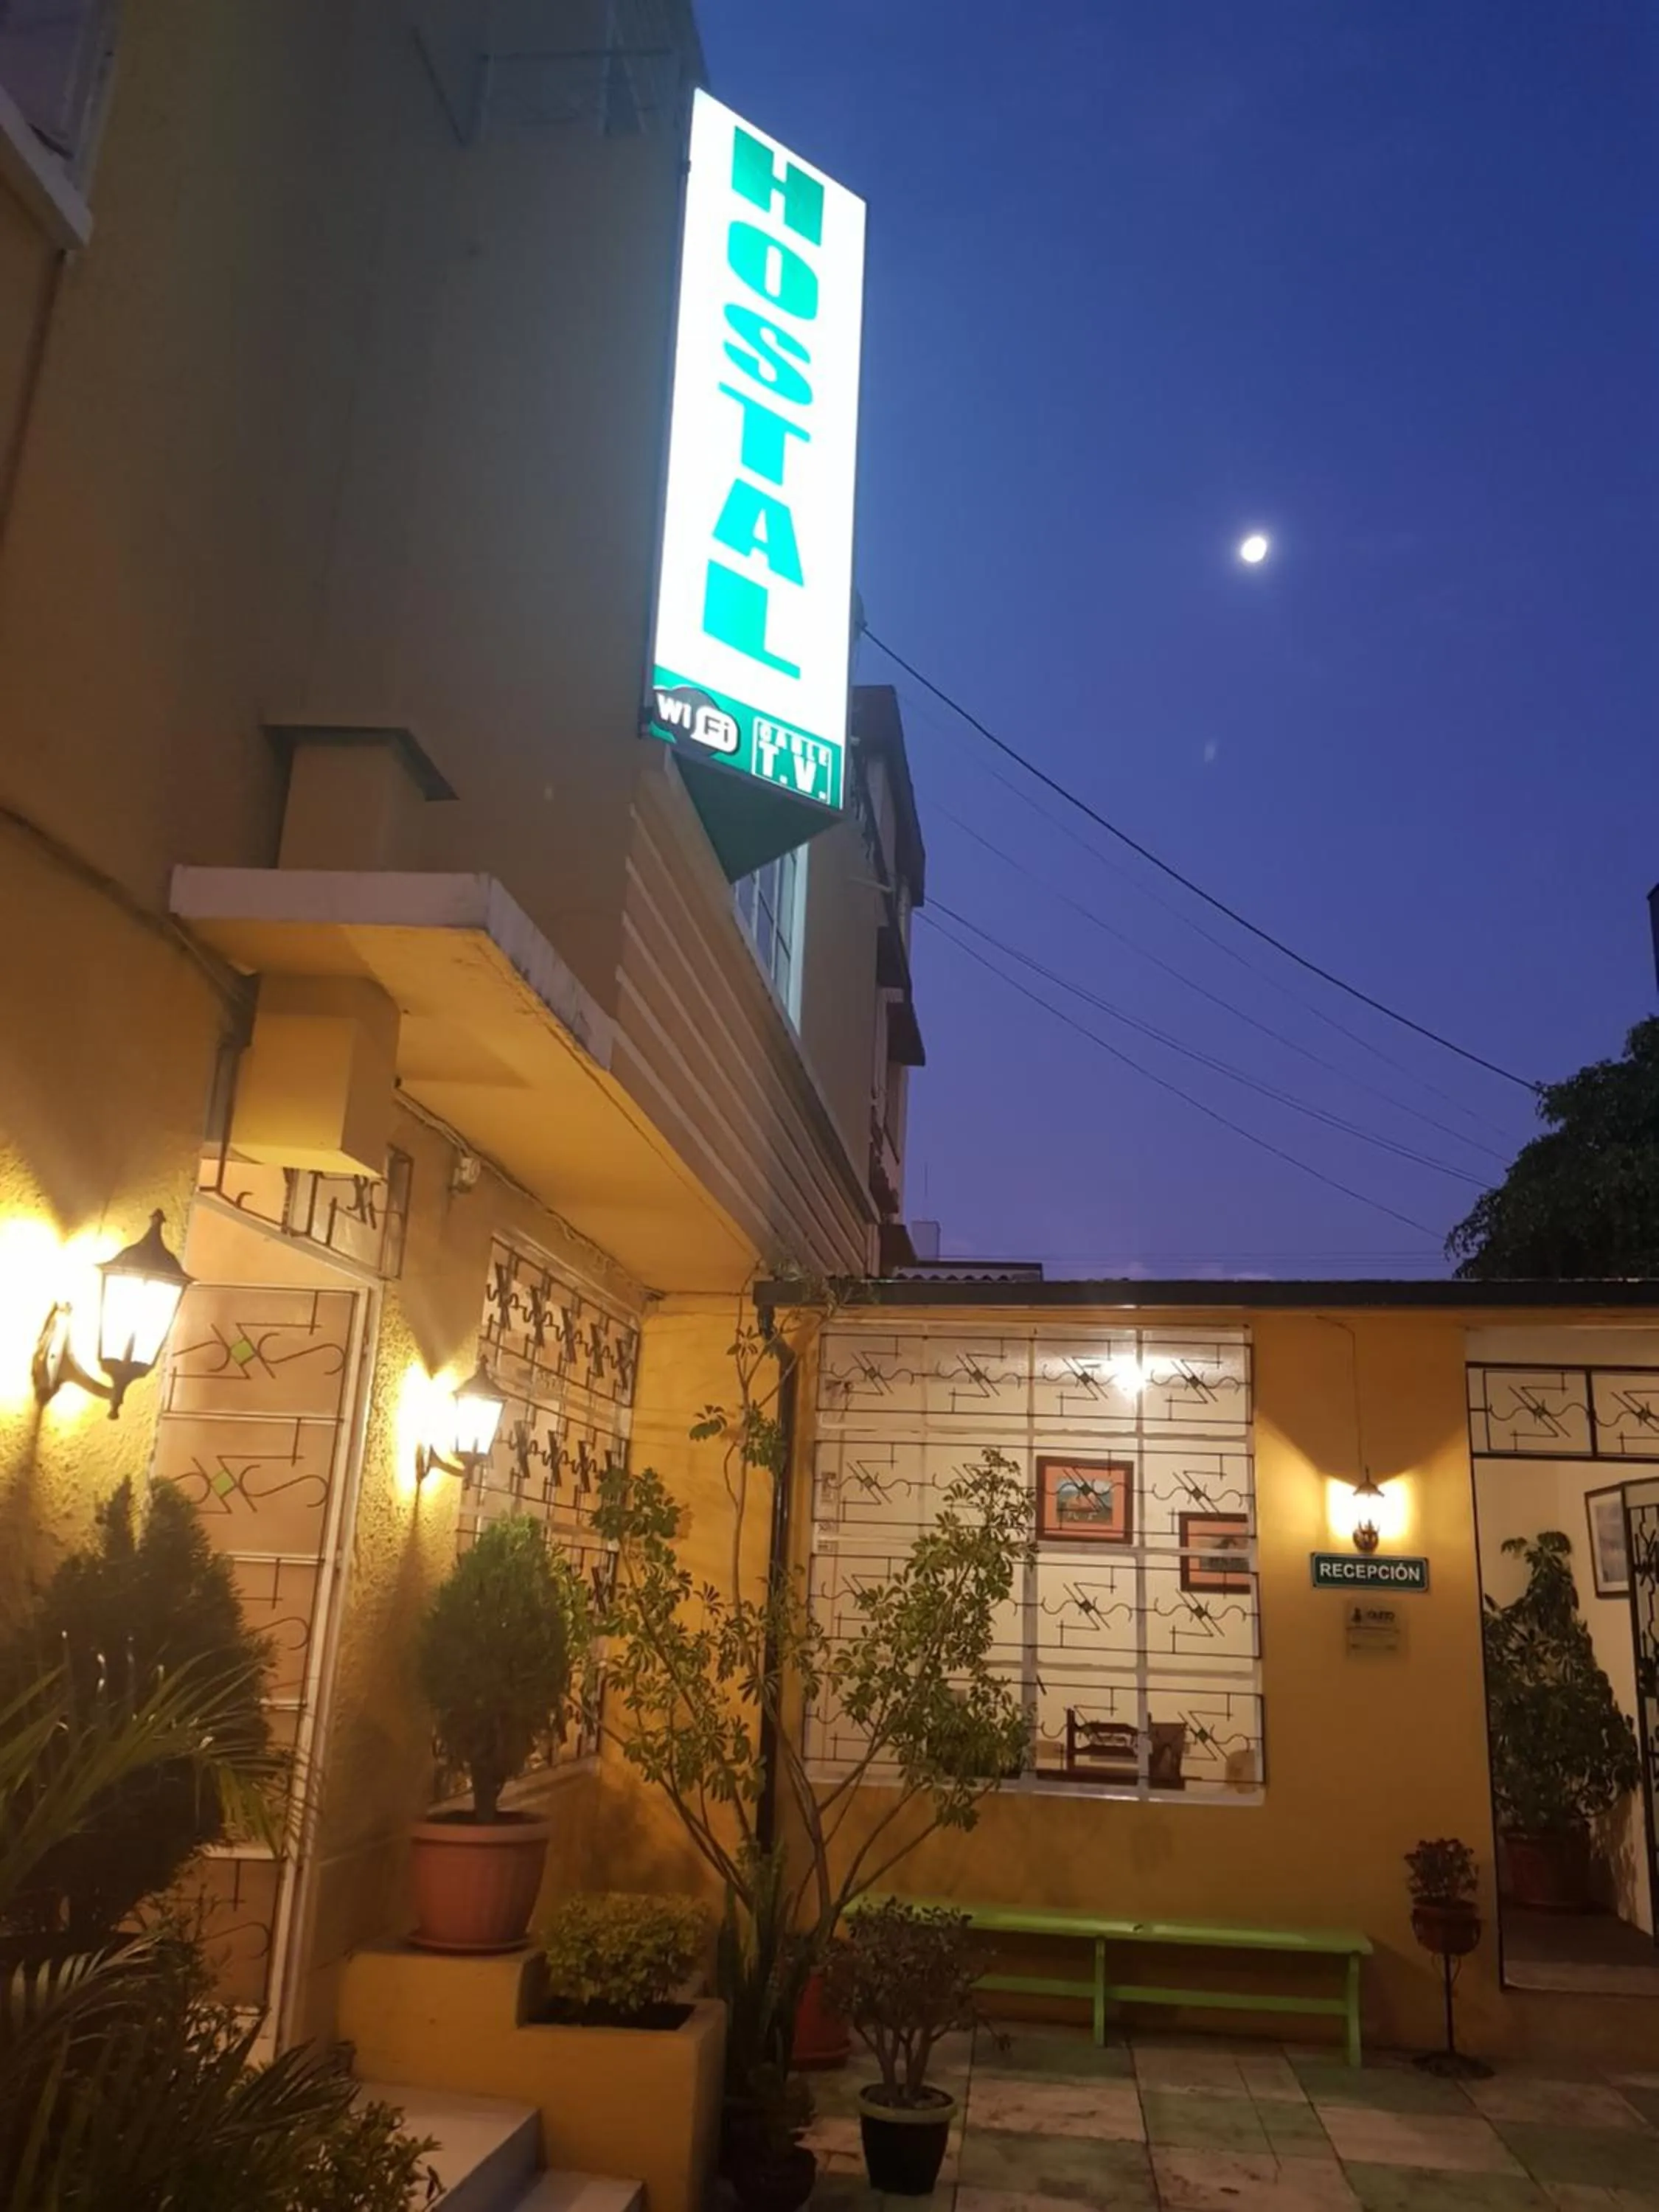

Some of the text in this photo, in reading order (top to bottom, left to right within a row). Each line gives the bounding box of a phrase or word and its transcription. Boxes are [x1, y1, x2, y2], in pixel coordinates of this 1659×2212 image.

[703, 125, 825, 680] HOSTAL
[759, 740, 827, 800] T.V.
[1319, 1562, 1421, 1582] RECEPCIÓN
